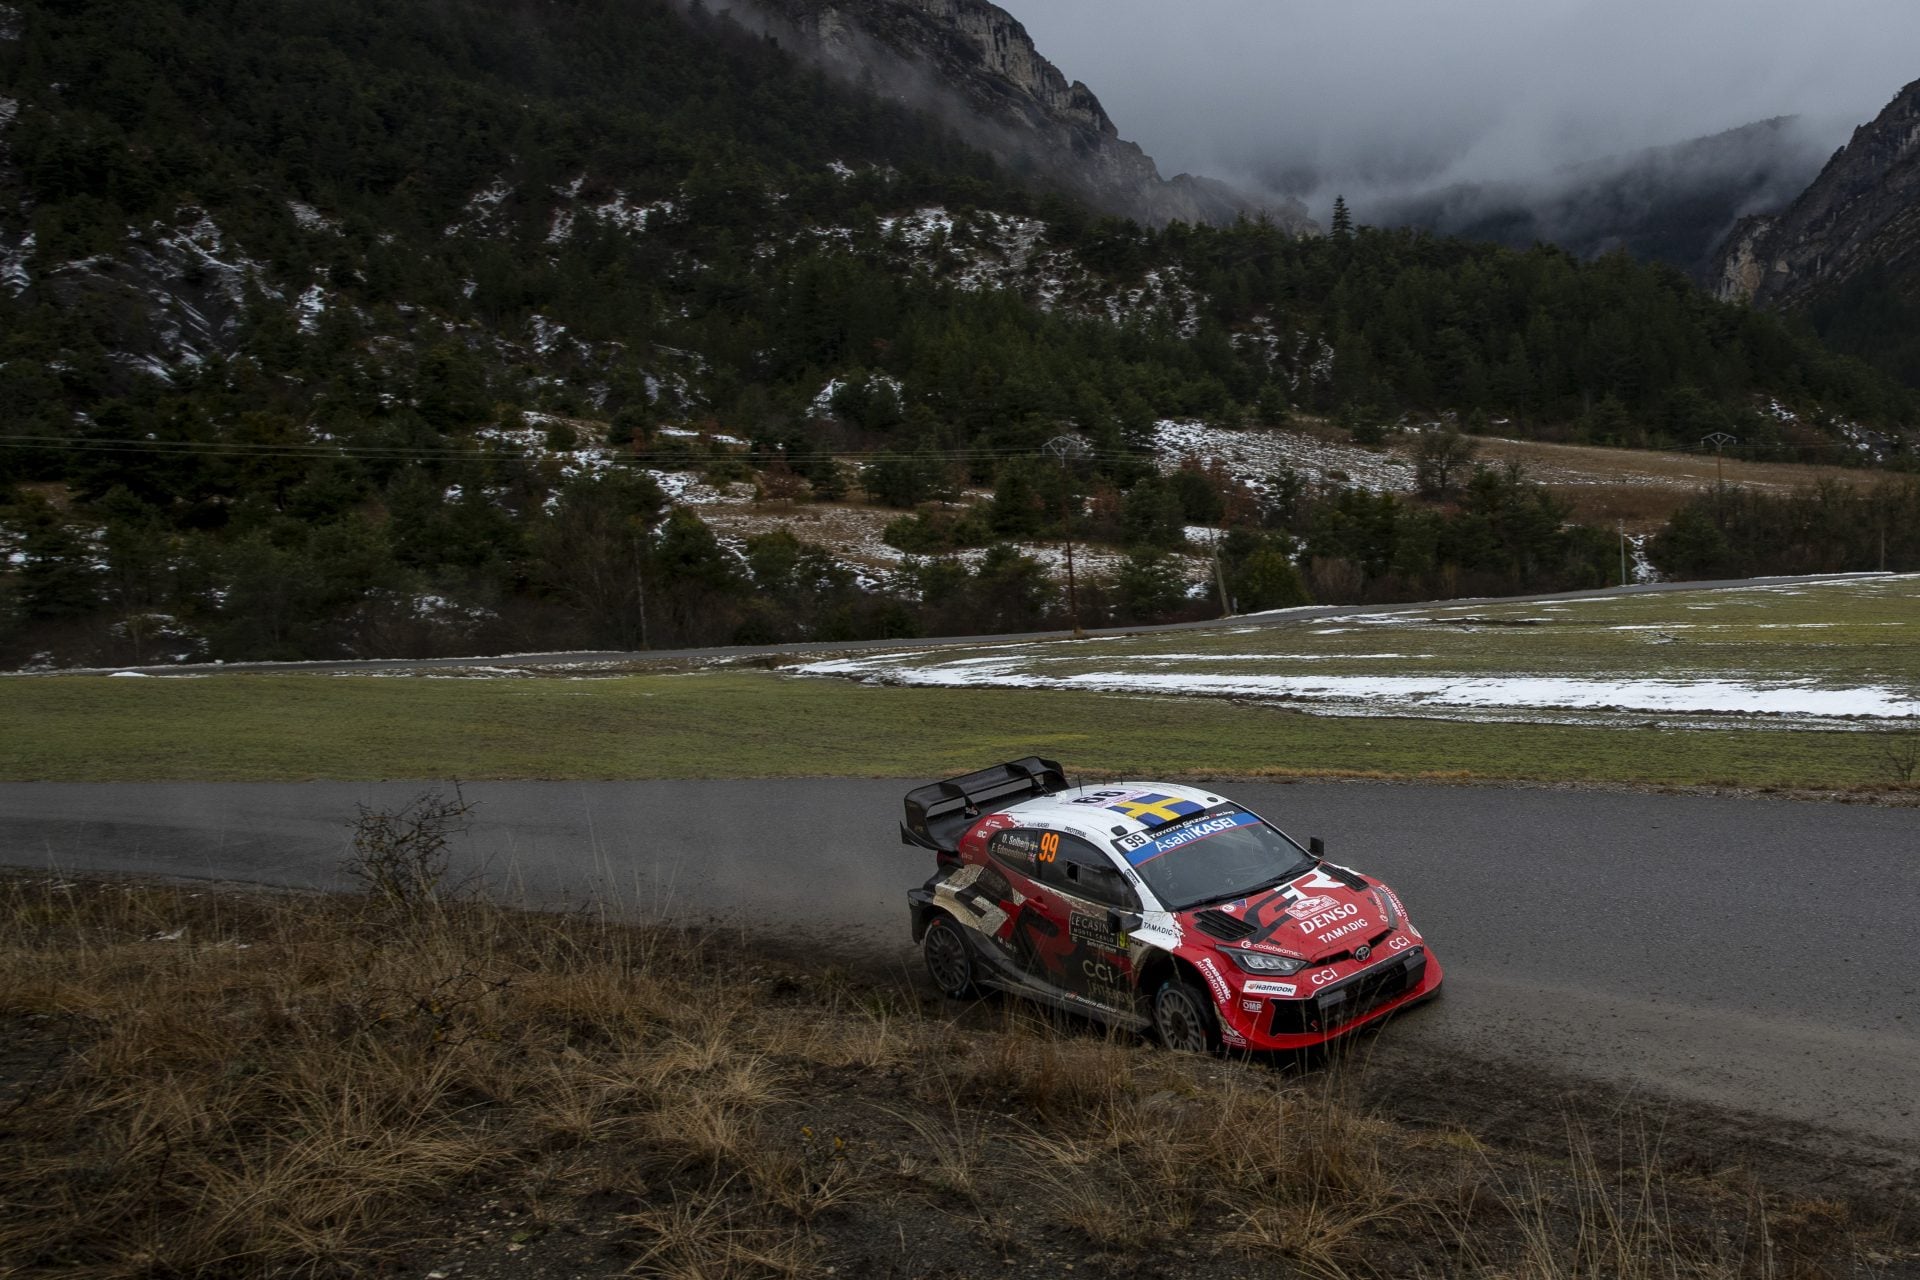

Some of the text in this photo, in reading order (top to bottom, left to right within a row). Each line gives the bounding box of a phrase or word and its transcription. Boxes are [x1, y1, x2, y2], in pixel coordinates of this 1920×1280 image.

[1149, 824, 1182, 839] TOYOTA
[1182, 815, 1210, 828] GAZOO
[1038, 832, 1060, 863] 99
[1124, 834, 1147, 848] 99
[1071, 915, 1116, 936] LE CASIN
[1143, 921, 1174, 936] TAMADIC
[1299, 903, 1359, 935] DENSO
[1317, 918, 1368, 943] TAMADIC
[1195, 960, 1226, 1005] AUTOMOTIVE
[1202, 957, 1232, 1000] Panasonic
[1243, 1001, 1262, 1011] OMP
